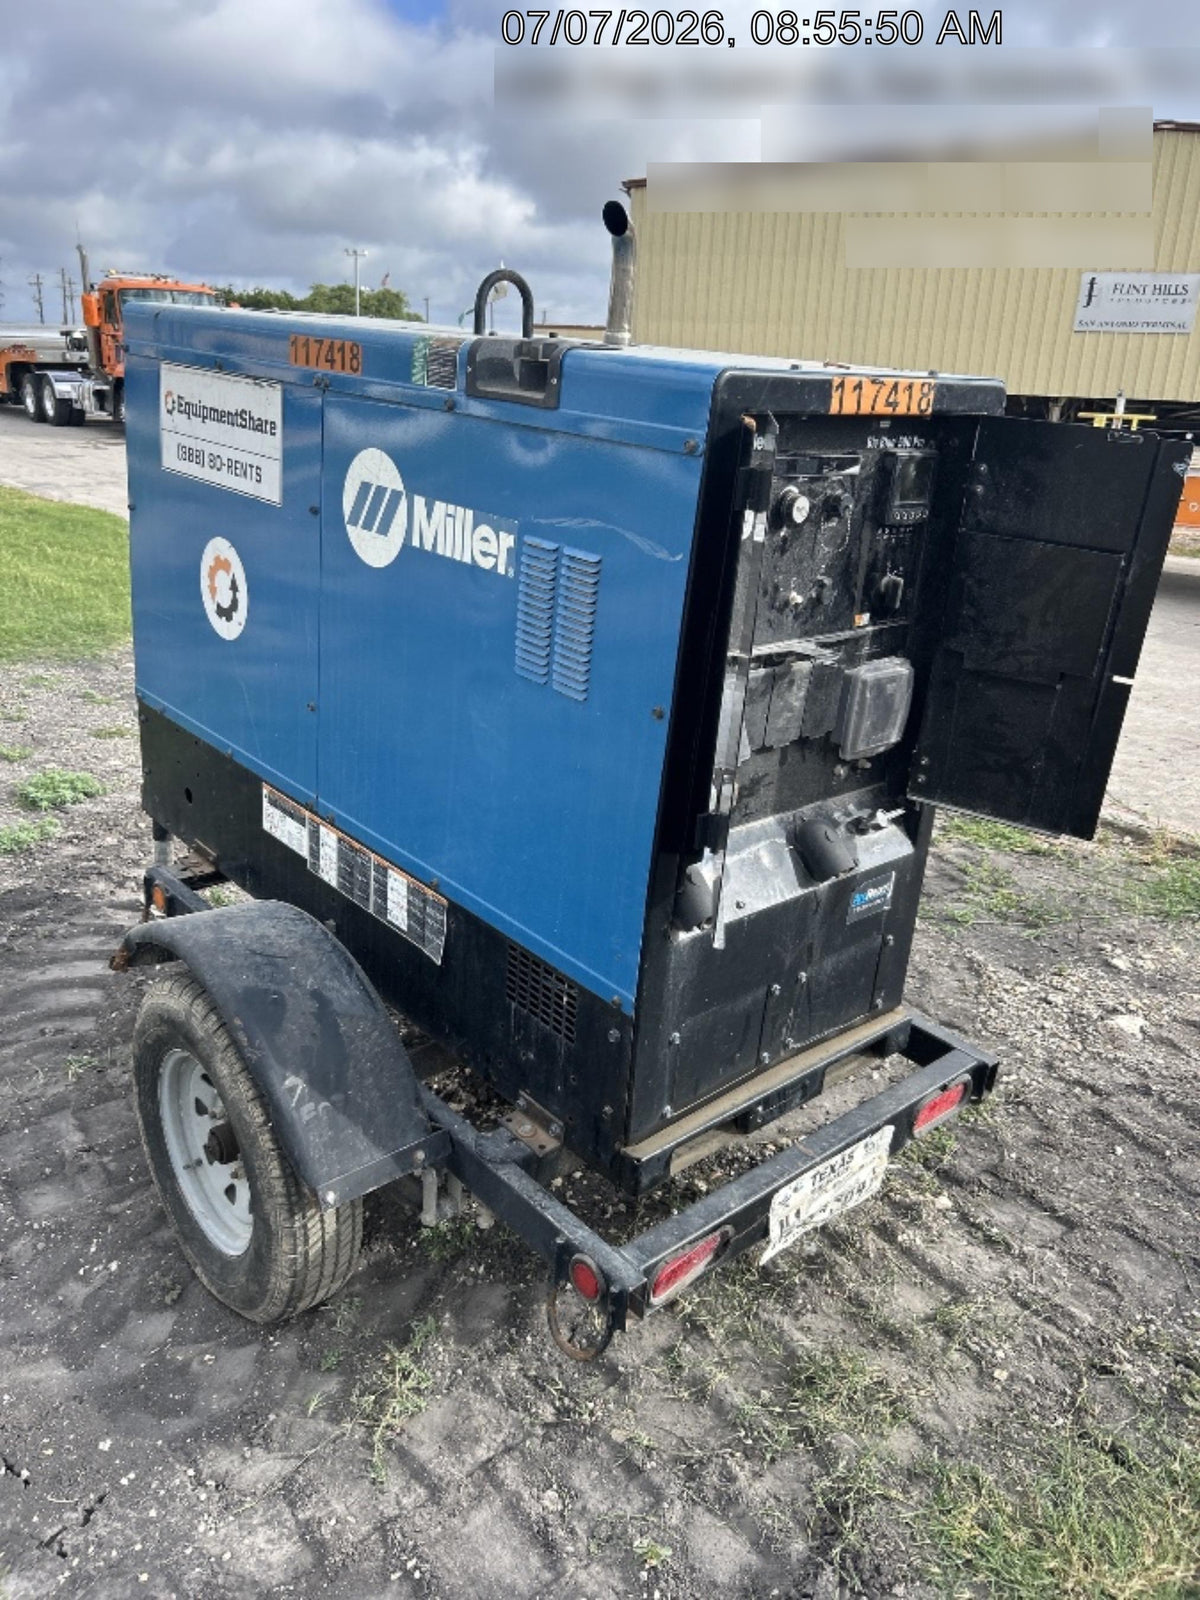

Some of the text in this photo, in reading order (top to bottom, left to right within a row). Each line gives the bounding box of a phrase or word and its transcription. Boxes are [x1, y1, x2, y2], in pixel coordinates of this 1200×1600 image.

[1112, 283, 1189, 296] FLINT HILLS
[290, 336, 361, 374] 117418
[177, 394, 277, 436] EquipmentShare
[834, 377, 935, 415] 117418
[177, 442, 262, 483] (888) 80-RENTS
[412, 494, 515, 575] Miller
